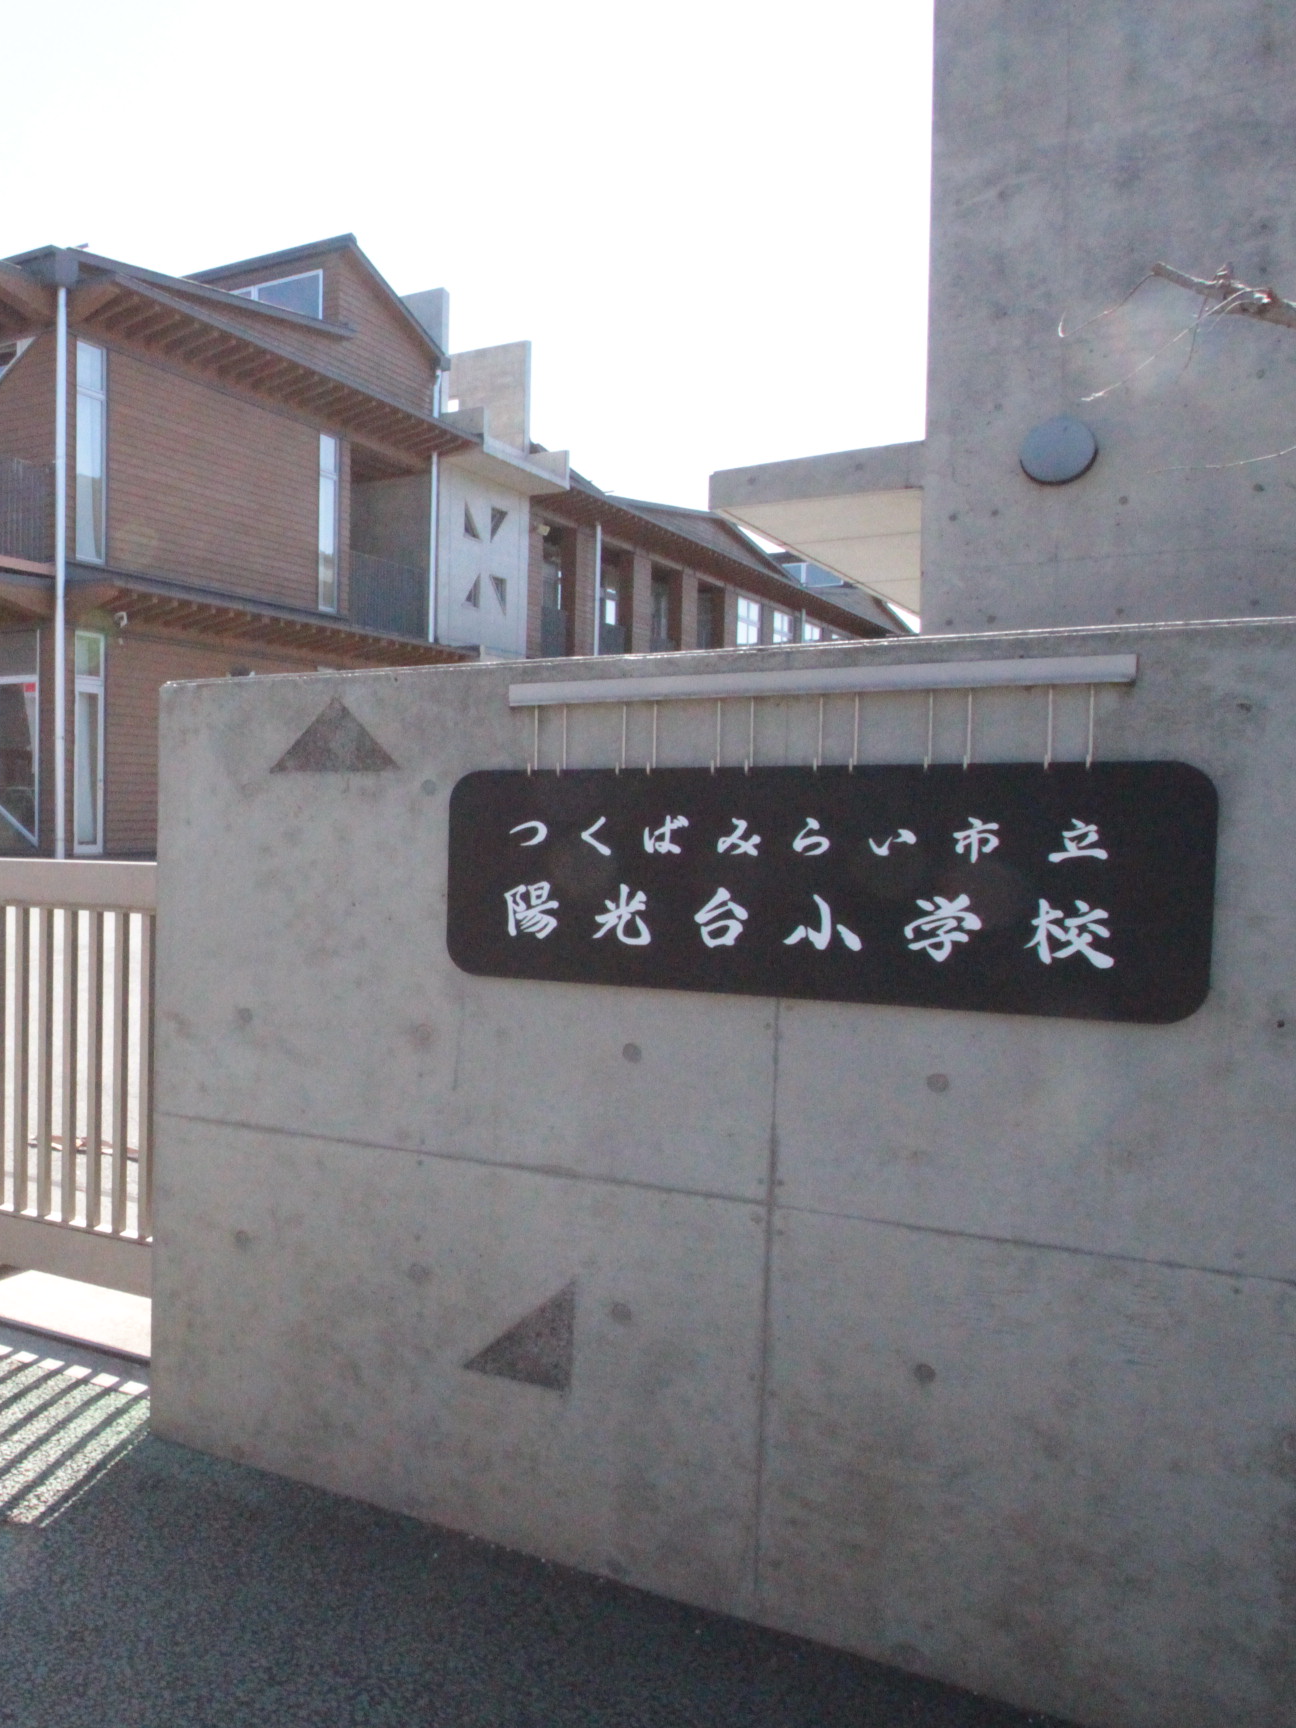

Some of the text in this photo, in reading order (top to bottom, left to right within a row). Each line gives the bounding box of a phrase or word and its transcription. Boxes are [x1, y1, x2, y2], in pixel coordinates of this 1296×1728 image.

[509, 814, 1108, 864] つくばみらい市立
[503, 881, 1114, 969] 陽光台小学校
